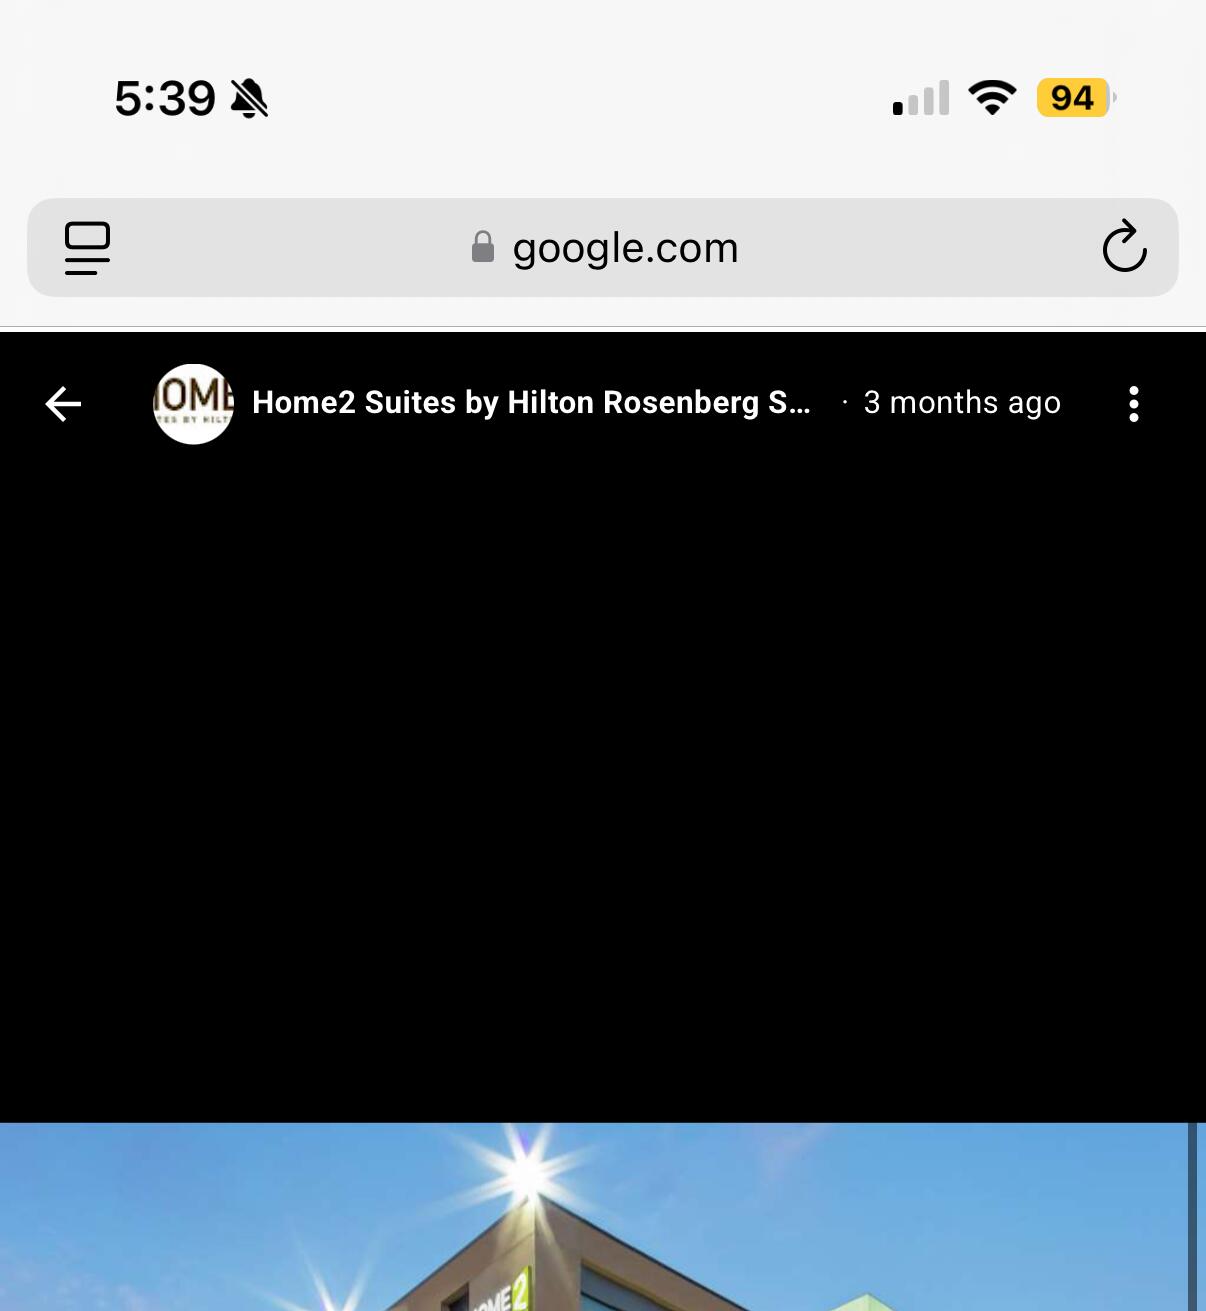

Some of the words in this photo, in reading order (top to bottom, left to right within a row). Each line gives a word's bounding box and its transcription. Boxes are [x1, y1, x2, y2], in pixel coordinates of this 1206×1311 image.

[115, 79, 216, 117] 5:39
[1051, 84, 1095, 112] 94
[513, 230, 738, 271] google.com
[153, 377, 235, 411] OME
[253, 389, 356, 415] Home2
[364, 389, 456, 415] Suites
[465, 388, 500, 421] by
[508, 388, 594, 415] Hilton
[604, 388, 759, 421] Rosenberg
[864, 389, 880, 415] 3
[890, 388, 998, 415] months
[1008, 395, 1061, 421] ago
